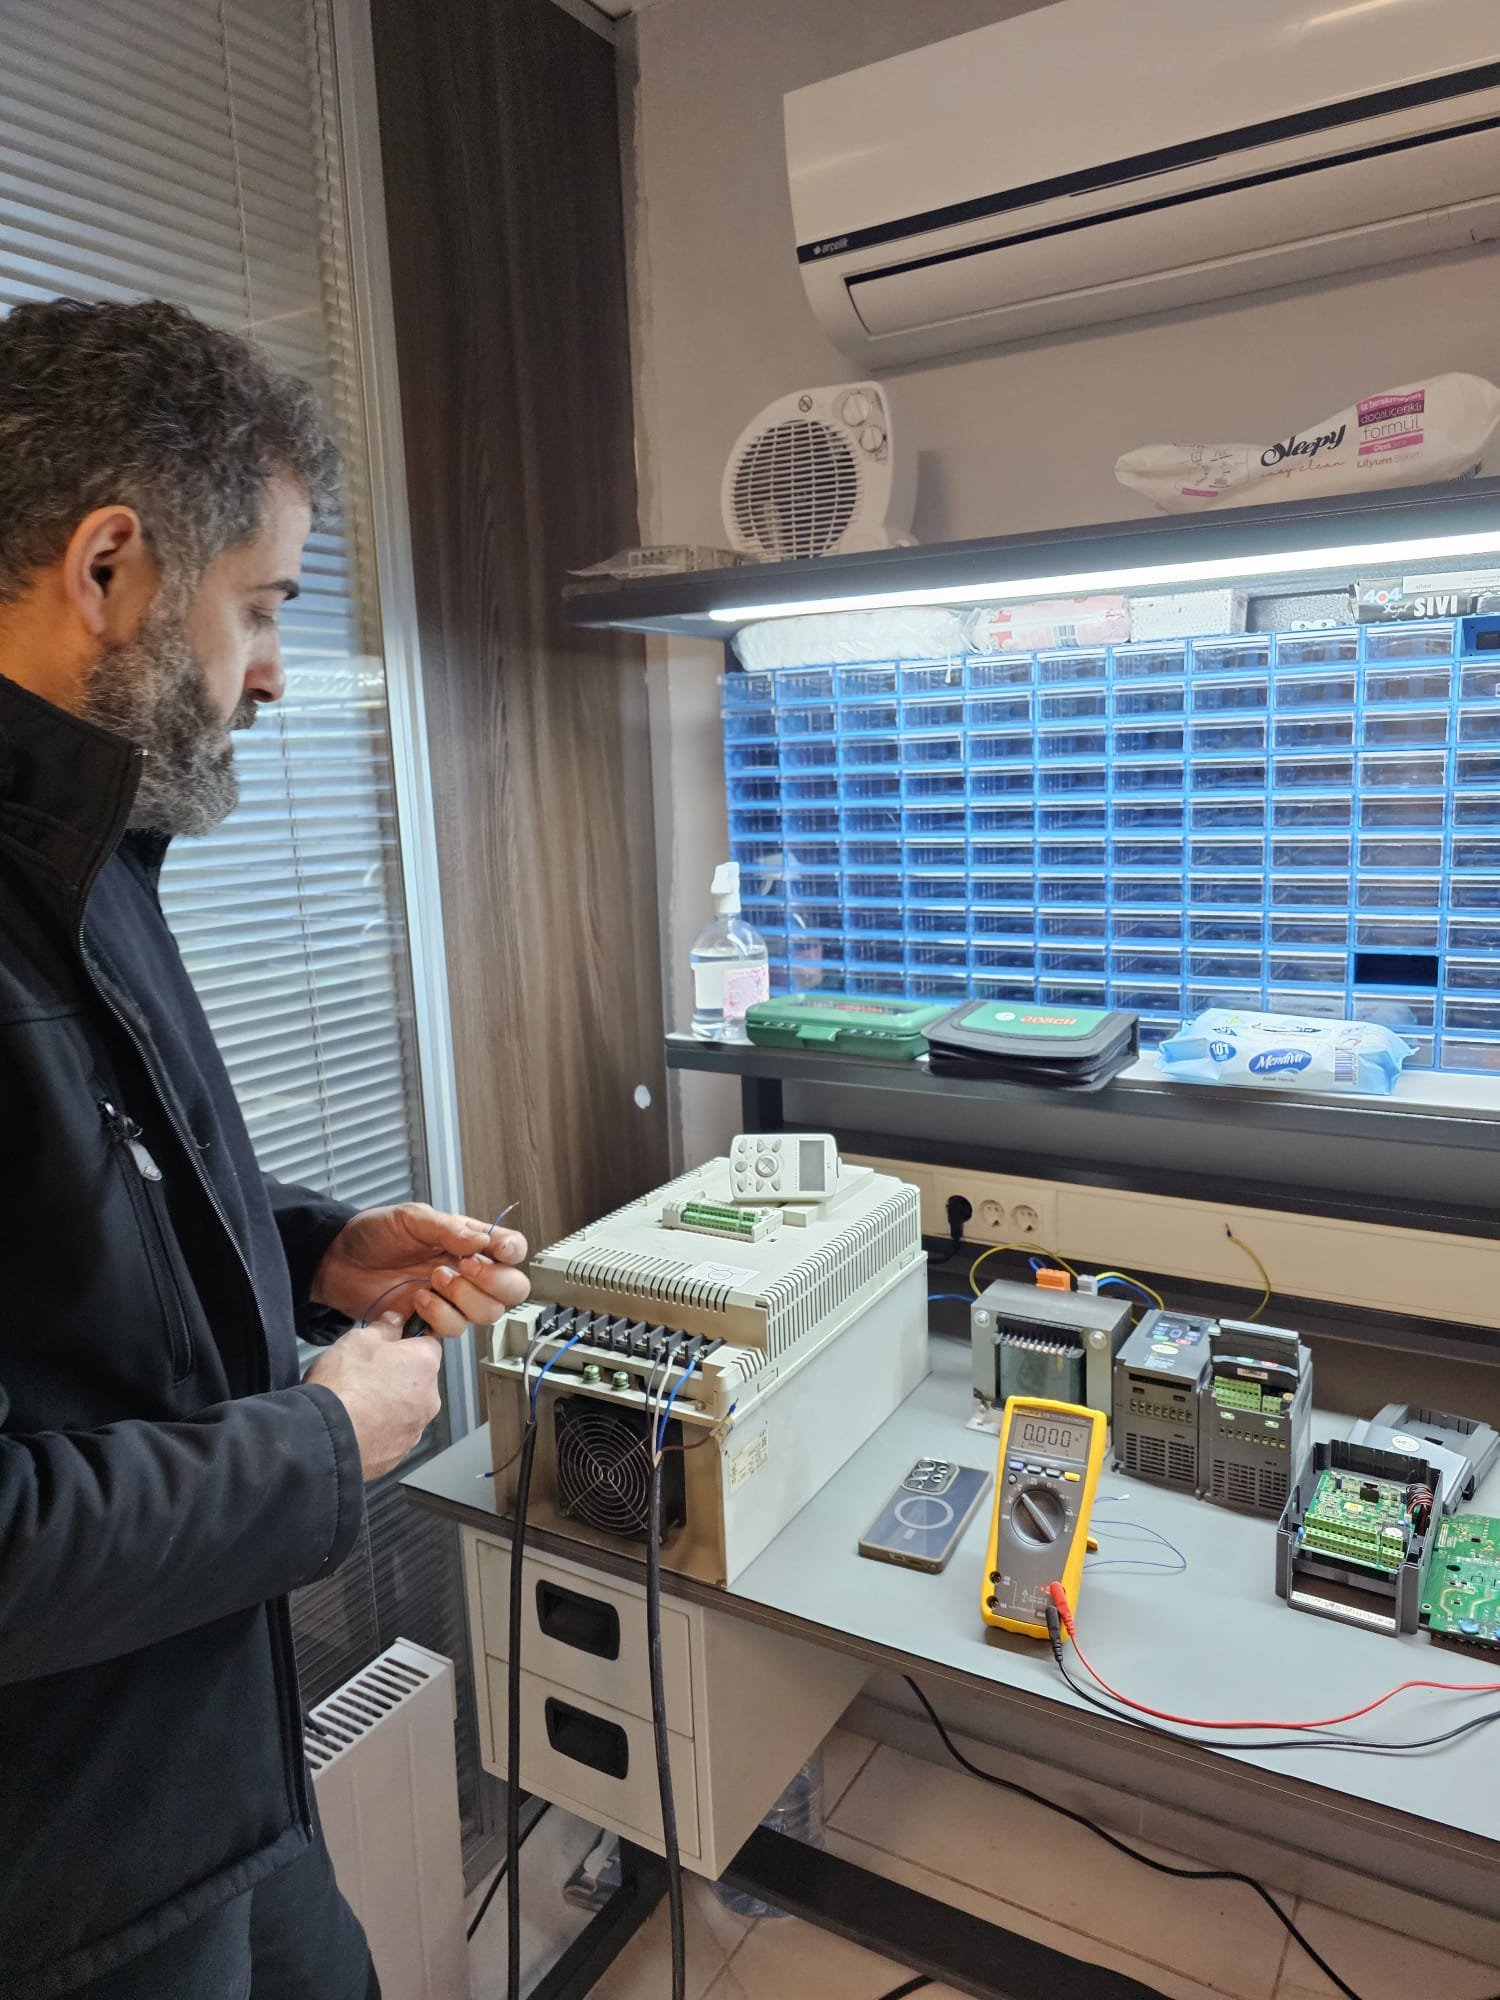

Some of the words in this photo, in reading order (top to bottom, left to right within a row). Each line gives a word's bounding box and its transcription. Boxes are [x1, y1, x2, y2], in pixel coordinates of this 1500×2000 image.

[1363, 414, 1420, 441] formül
[1260, 424, 1346, 467] Sleepy
[1357, 457, 1392, 469] Lilyum
[1363, 586, 1402, 605] 404
[1413, 594, 1458, 617] SIVI
[1211, 1043, 1229, 1056] 101
